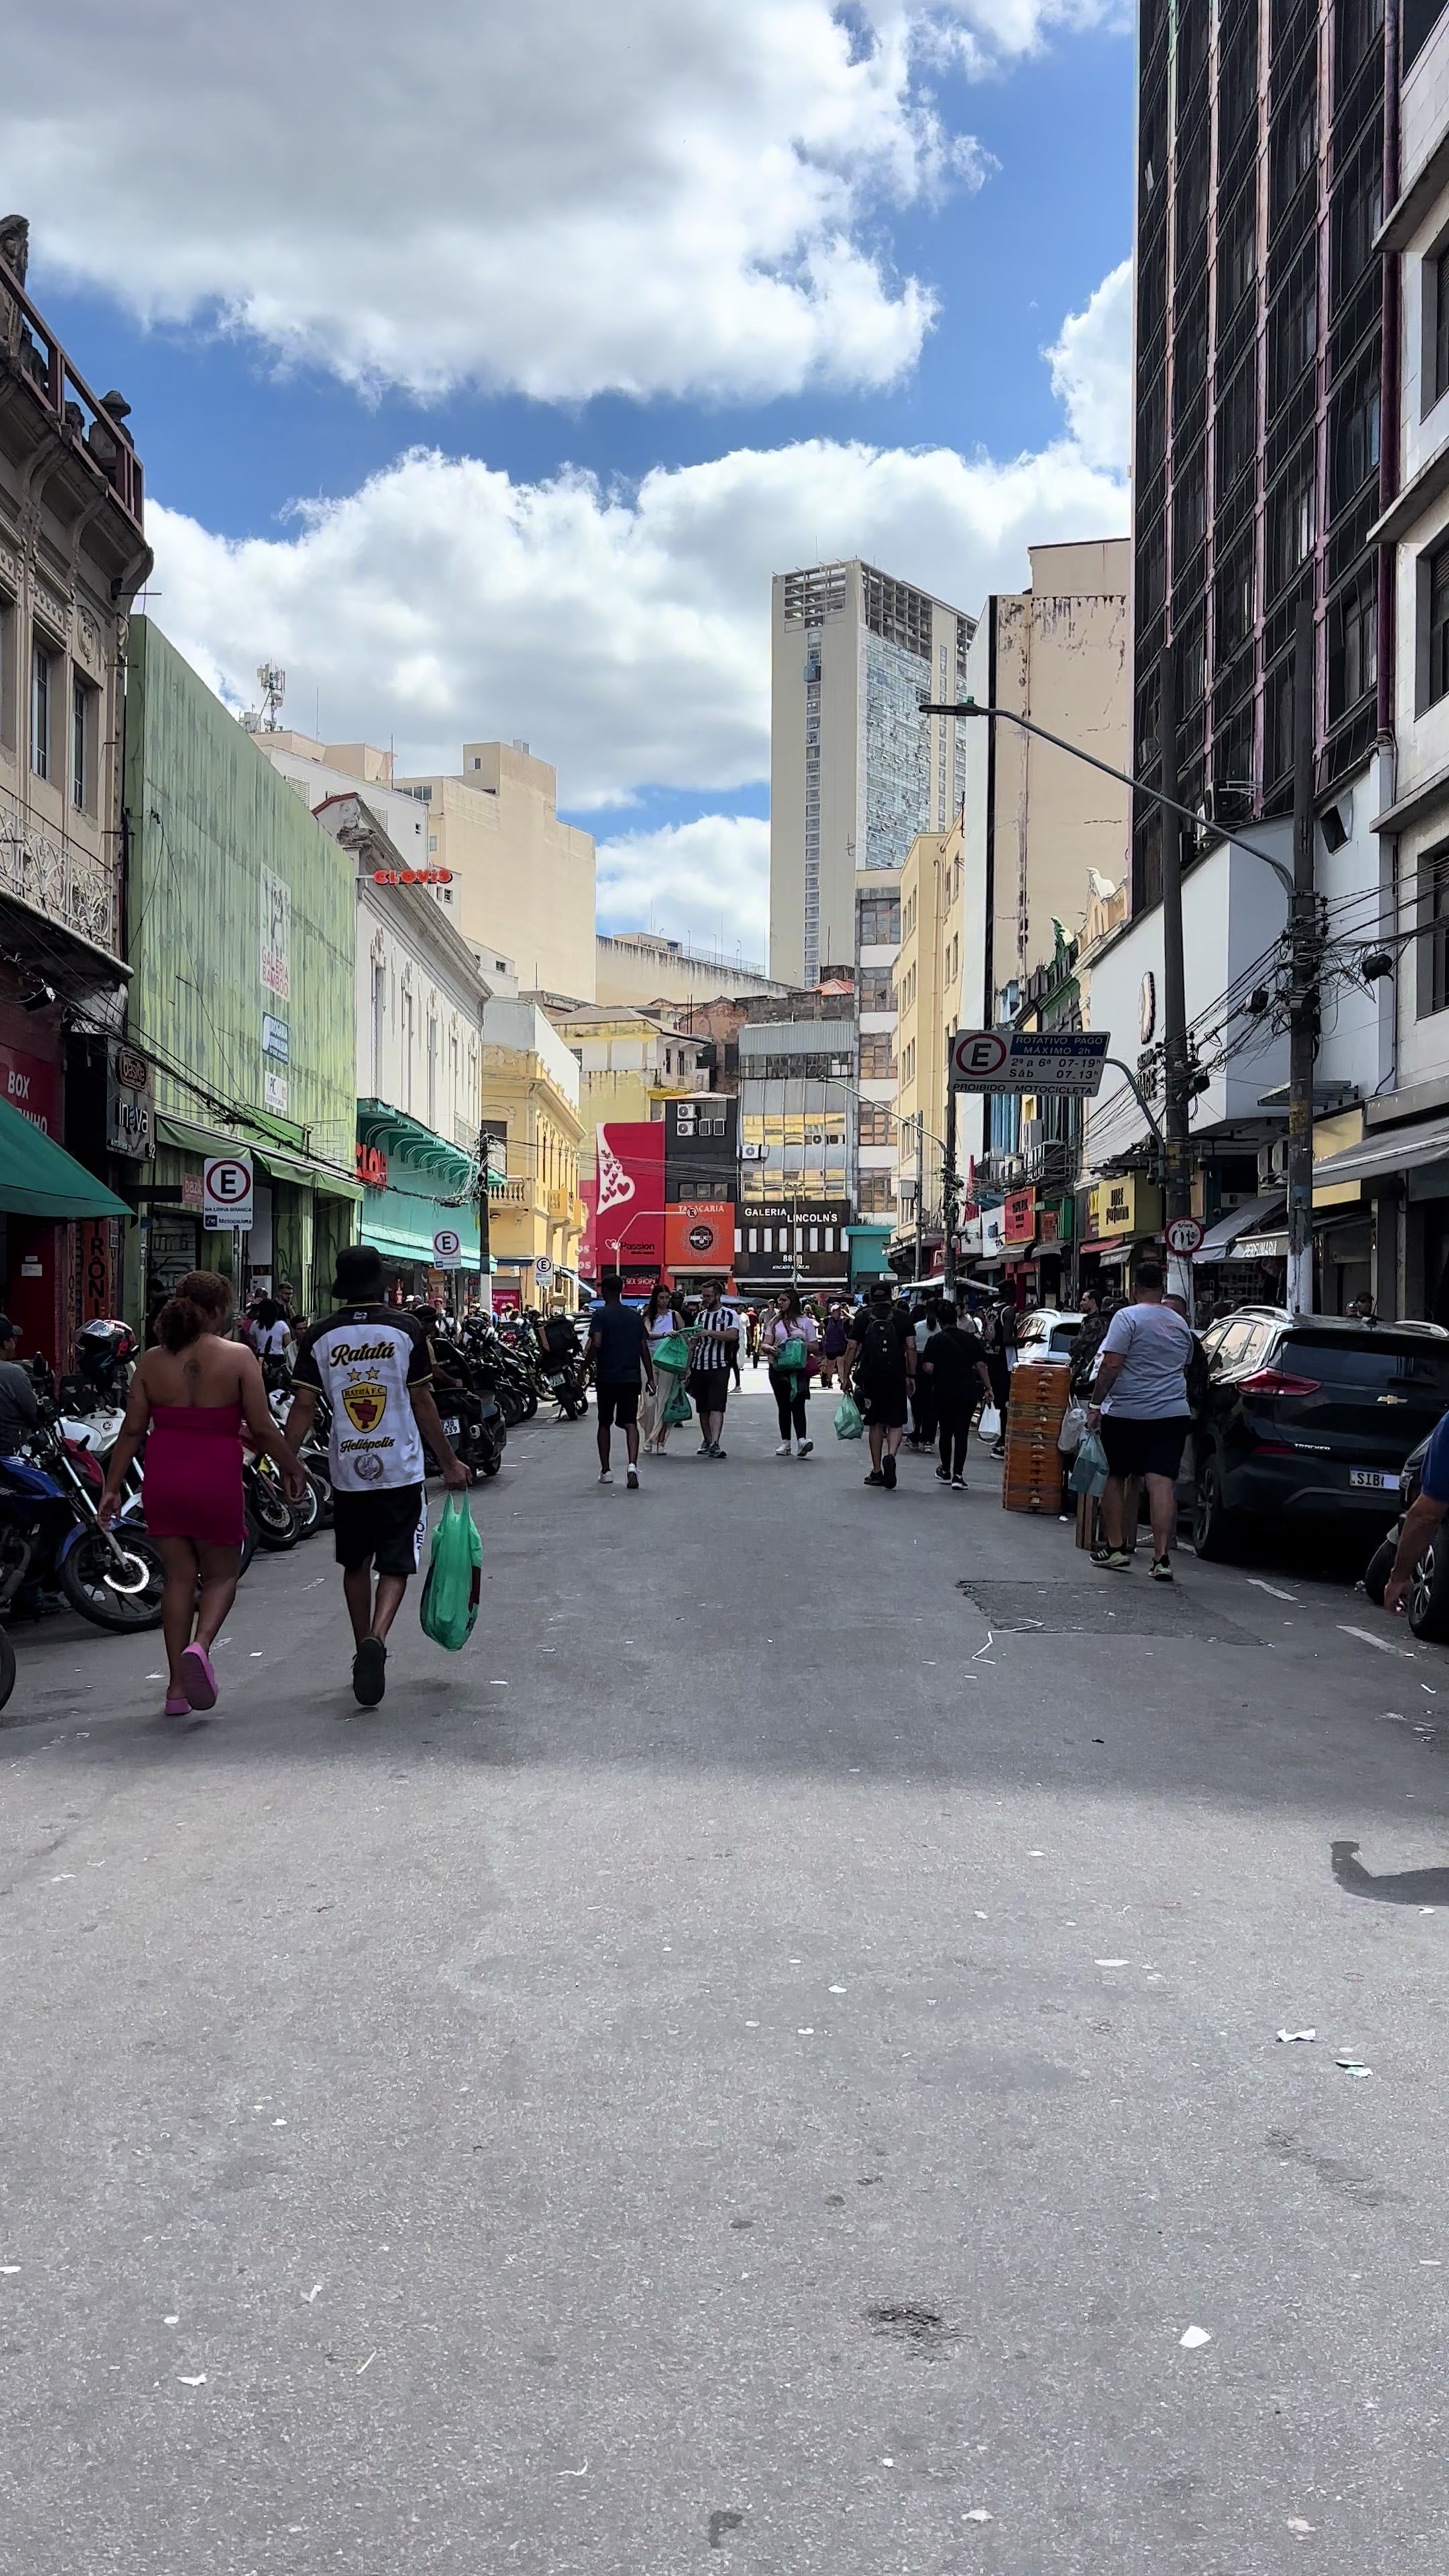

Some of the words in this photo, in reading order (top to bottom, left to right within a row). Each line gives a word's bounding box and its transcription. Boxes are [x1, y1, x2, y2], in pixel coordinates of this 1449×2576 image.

[262, 946, 288, 983] GALERIA
[262, 965, 288, 998] BAMBOO
[1016, 1036, 1068, 1045] ROTATIVO
[1074, 1036, 1103, 1045] PAGO
[971, 1042, 992, 1067] E
[1024, 1046, 1071, 1055] MÁXIMO
[1077, 1047, 1091, 1055] 2h
[1009, 1068, 1034, 1078] Sáb
[7, 1070, 31, 1100] BOX
[953, 1083, 1006, 1092] PROIBIDO
[1014, 1085, 1093, 1095] MOTOCICLETA
[221, 1169, 237, 1194] E
[745, 1208, 787, 1217] GALERIA
[441, 1236, 451, 1250] E
[620, 1242, 655, 1250] Passion
[541, 1260, 547, 1270] E
[329, 1341, 396, 1367] Ratatá
[340, 1437, 396, 1453] Heliópolis
[1357, 1472, 1384, 1487] SIB
